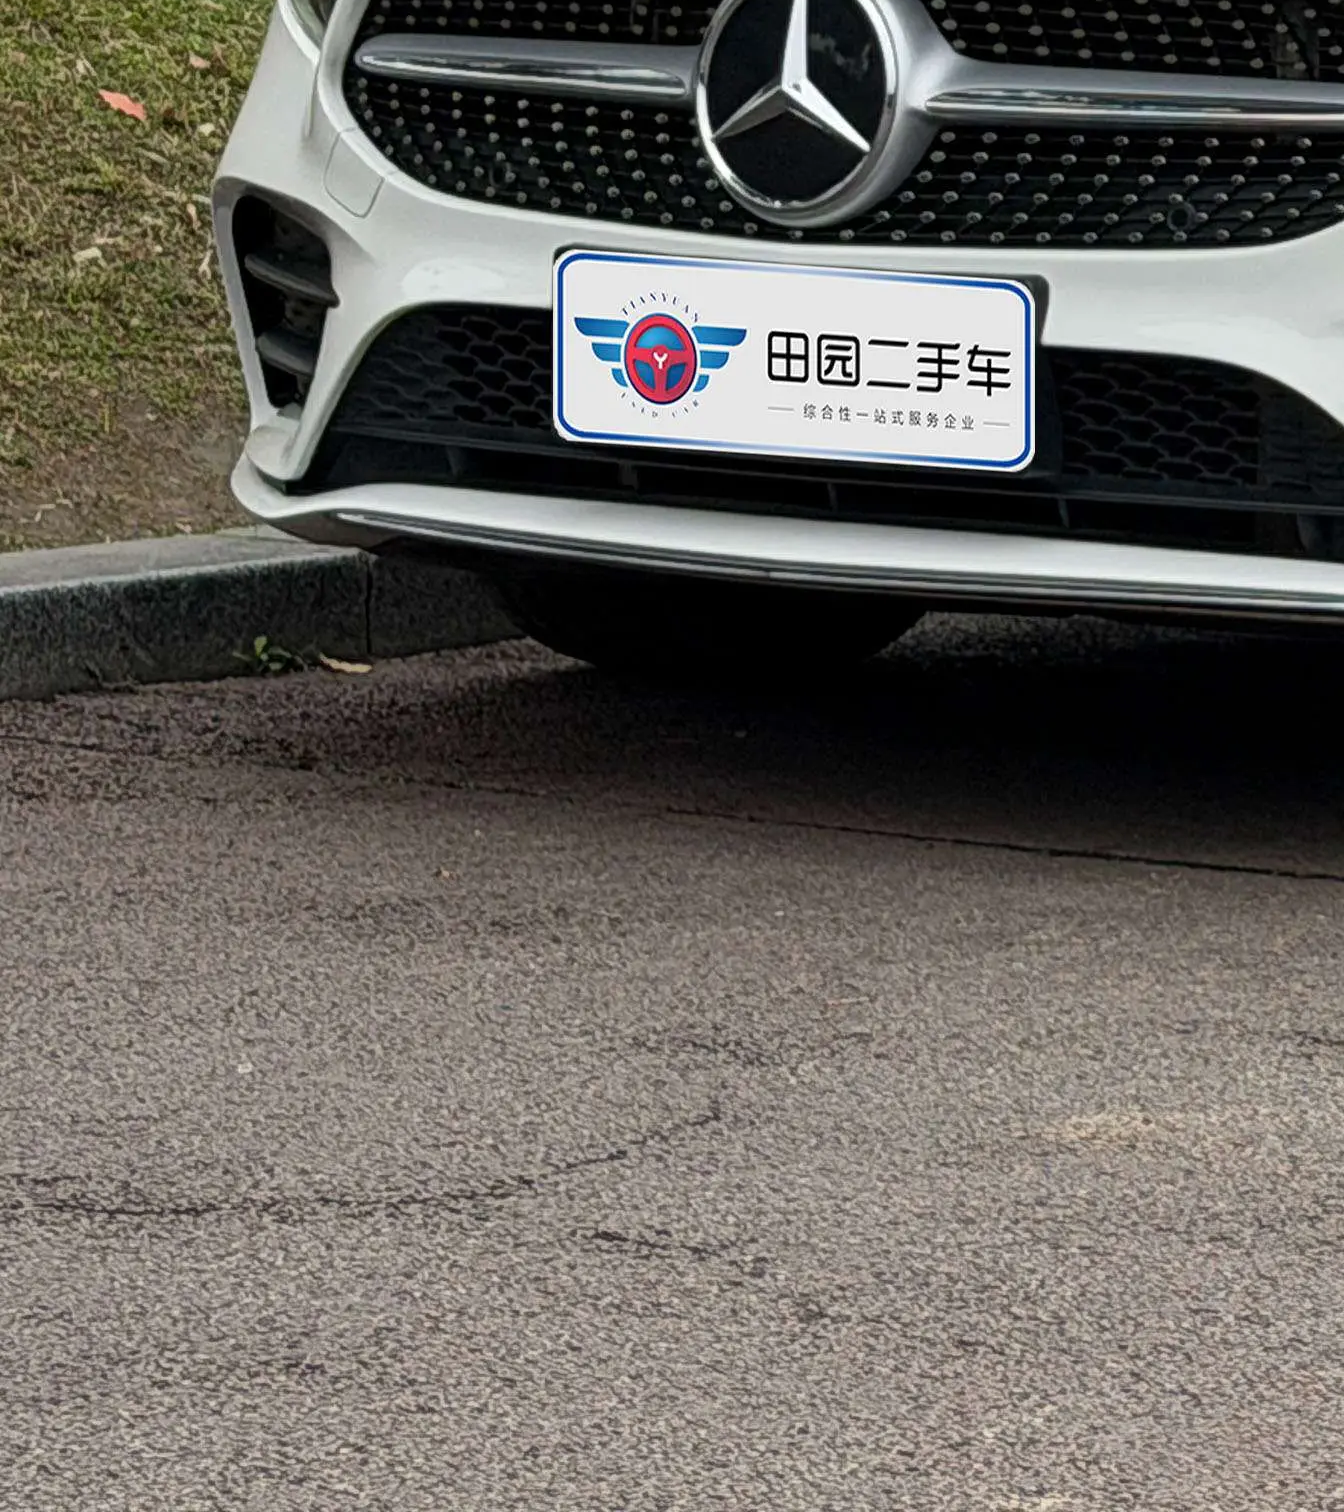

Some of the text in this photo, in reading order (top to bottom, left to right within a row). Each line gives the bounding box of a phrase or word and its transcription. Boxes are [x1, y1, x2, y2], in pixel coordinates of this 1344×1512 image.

[767, 330, 1012, 397] 田园二手车
[802, 402, 975, 431] 综合性一站式服务企业
